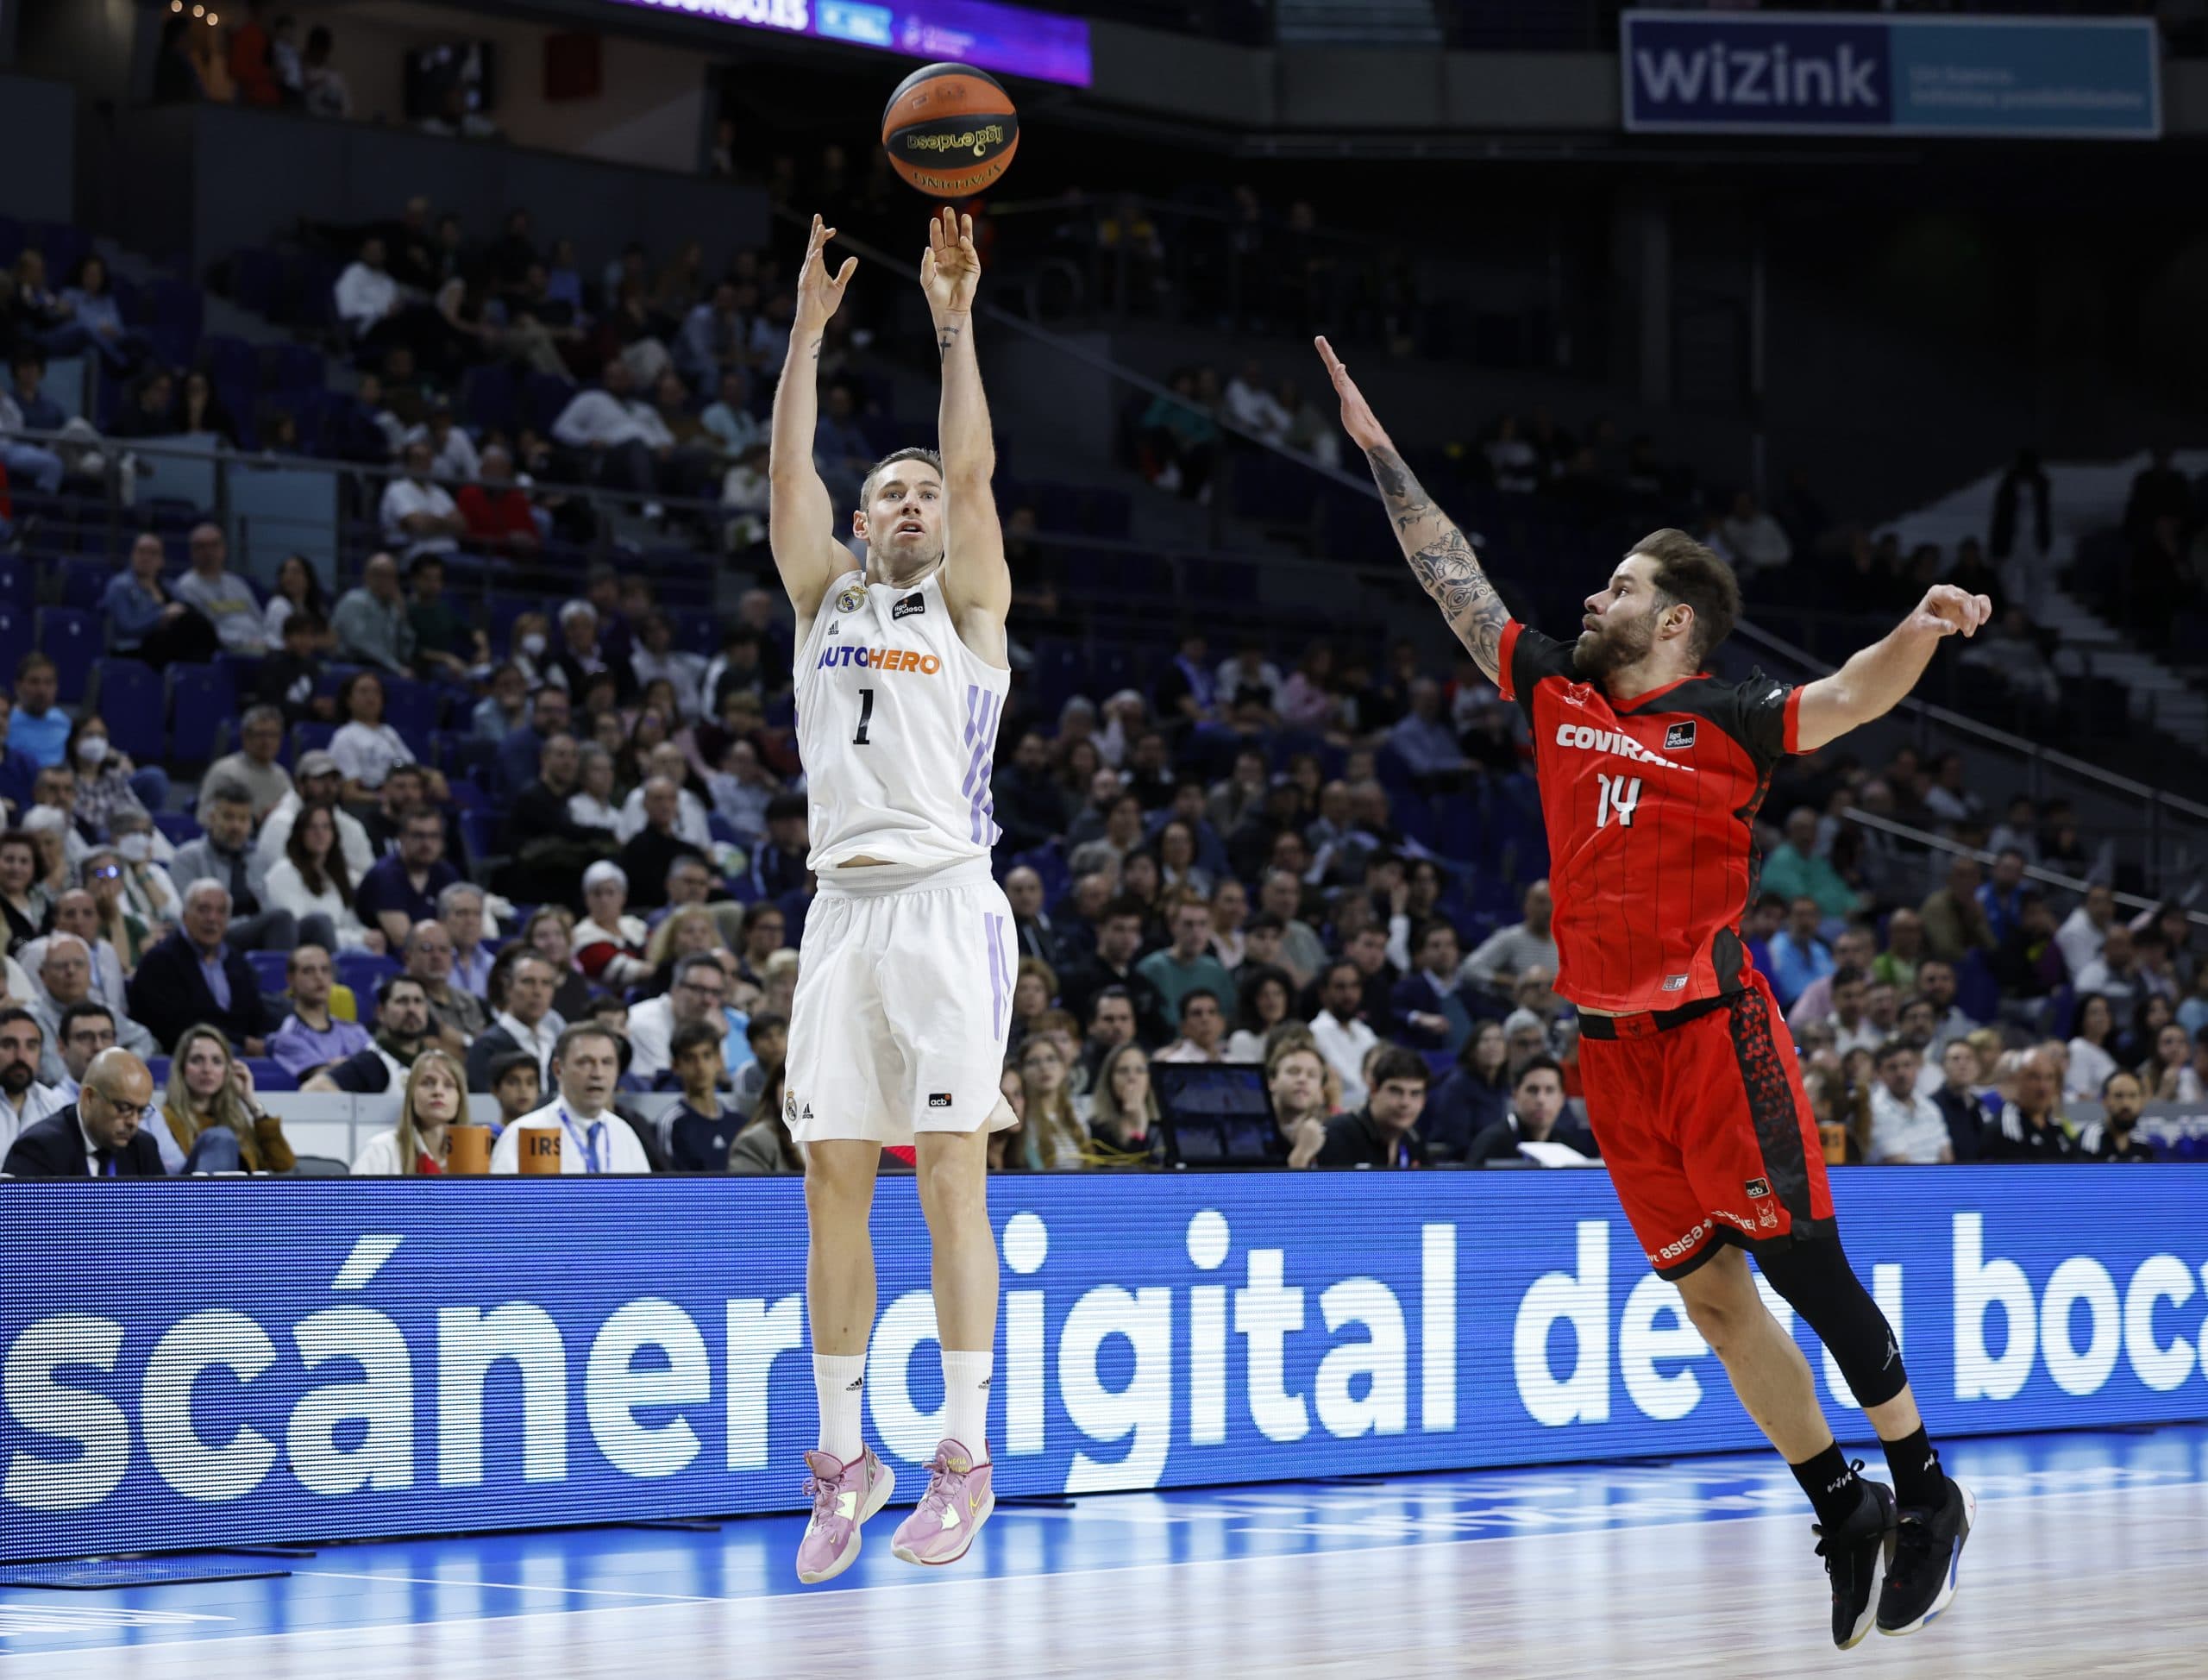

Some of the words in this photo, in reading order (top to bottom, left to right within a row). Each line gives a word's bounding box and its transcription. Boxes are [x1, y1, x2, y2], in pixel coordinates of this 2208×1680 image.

[1638, 42, 1879, 108] WiZink
[894, 605, 924, 617] endesa
[853, 689, 874, 744] 1
[1597, 773, 1642, 828] 14
[931, 1097, 947, 1106] acb
[1747, 1186, 1763, 1195] acb
[1659, 1226, 1703, 1259] asisa
[3, 1234, 805, 1511] scáner
[868, 1211, 1458, 1494] digital
[1514, 1219, 1710, 1427] de
[1953, 1213, 2208, 1401] boc
